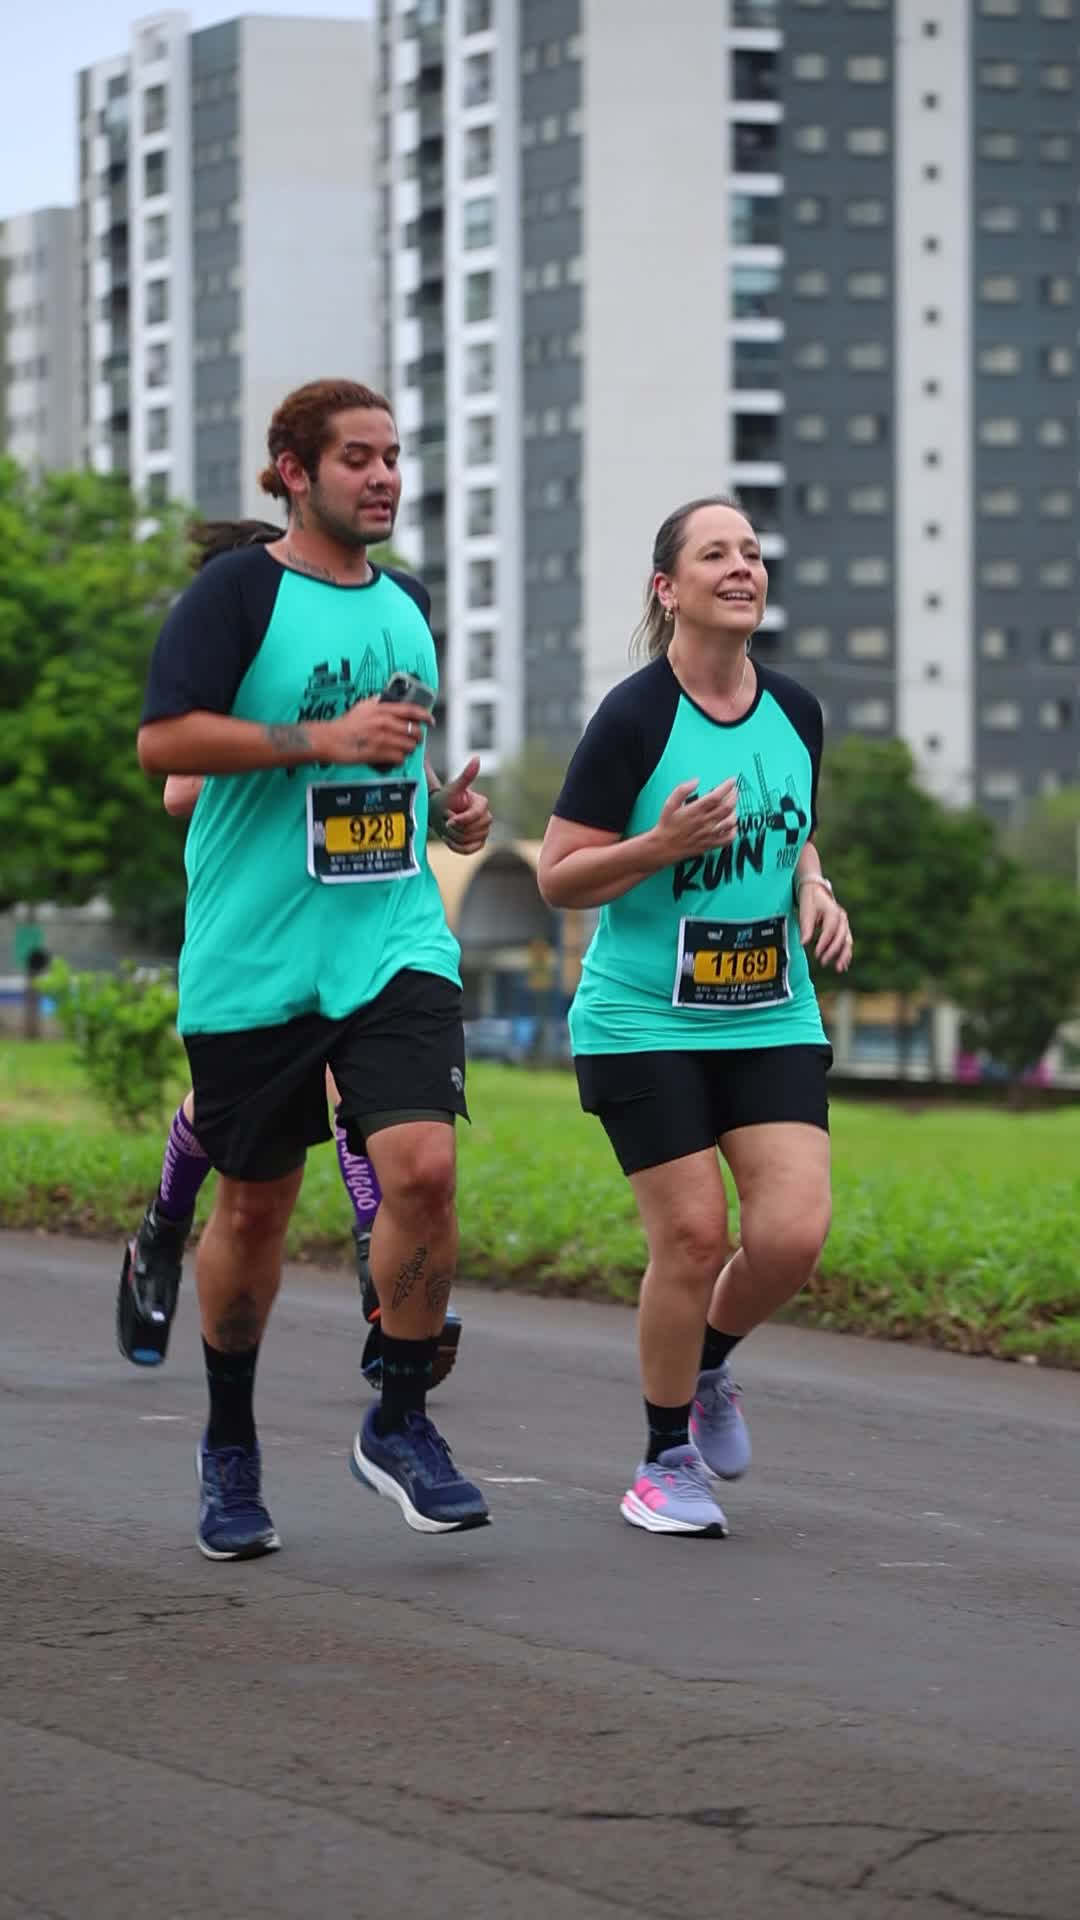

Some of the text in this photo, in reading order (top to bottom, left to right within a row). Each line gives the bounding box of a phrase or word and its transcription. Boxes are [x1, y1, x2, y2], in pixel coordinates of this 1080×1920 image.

[348, 814, 395, 845] 928
[672, 829, 767, 902] RUN
[711, 950, 769, 977] 1169
